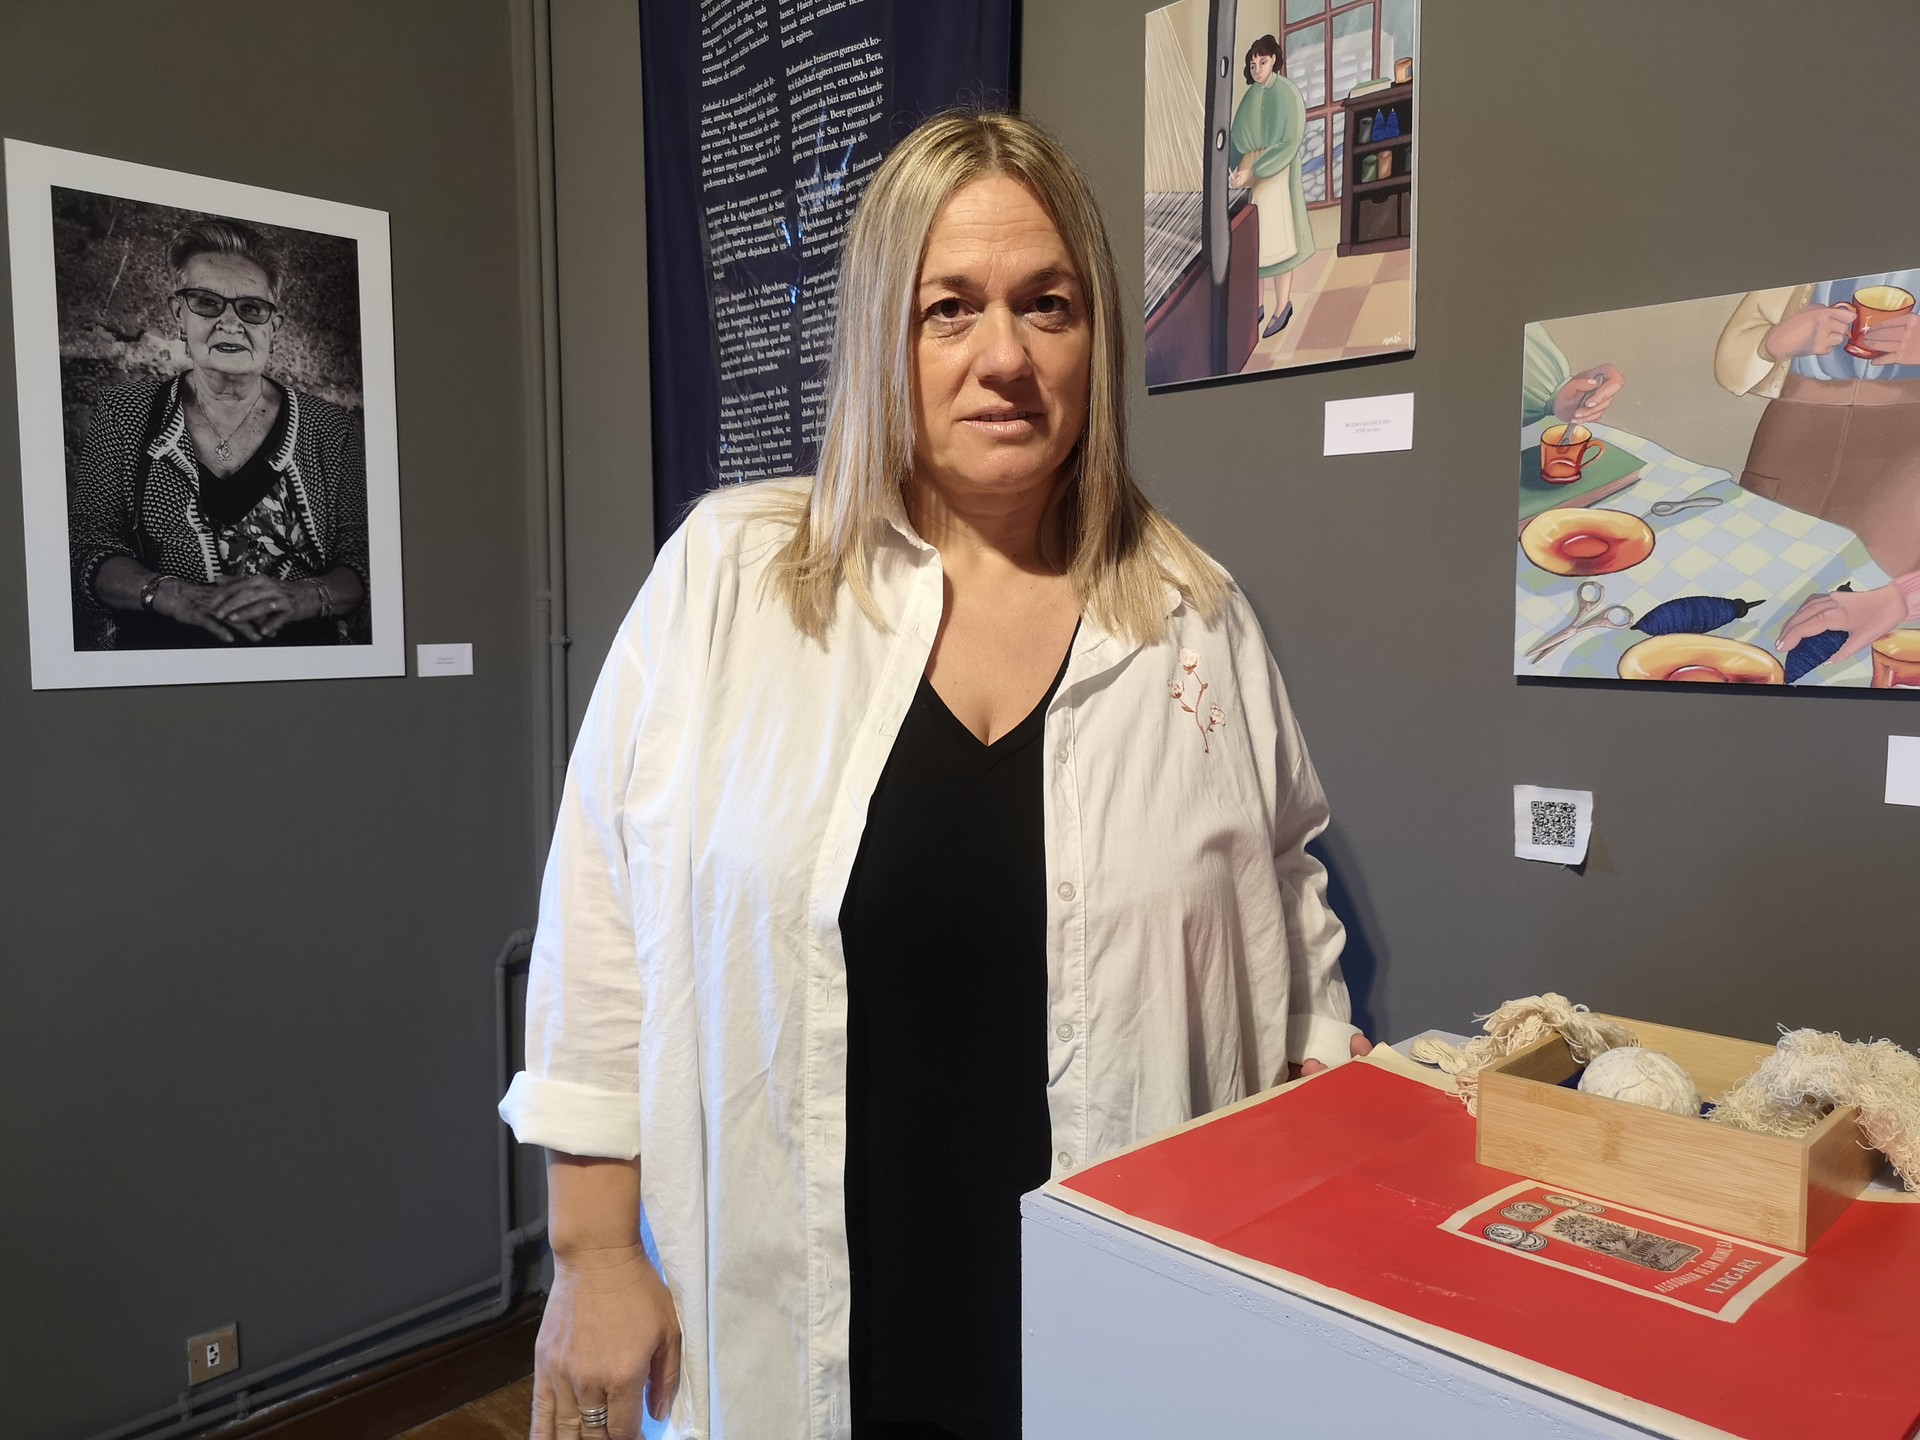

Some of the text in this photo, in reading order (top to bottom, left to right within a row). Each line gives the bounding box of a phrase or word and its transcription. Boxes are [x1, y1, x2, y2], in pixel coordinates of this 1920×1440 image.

[817, 1, 846, 17] emakume
[840, 39, 870, 57] gurasoek
[833, 62, 851, 73] zuten
[823, 82, 836, 91] zen,
[850, 71, 868, 83] ondo
[870, 67, 883, 77] asko
[827, 94, 839, 105] bizi
[840, 90, 857, 100] zuen
[830, 108, 846, 119] Bere
[847, 98, 875, 117] gurasoak
[827, 125, 839, 135] San
[842, 117, 868, 131] Antonio
[741, 144, 753, 153] Dice
[1705, 1258, 1762, 1293] VERGARA
